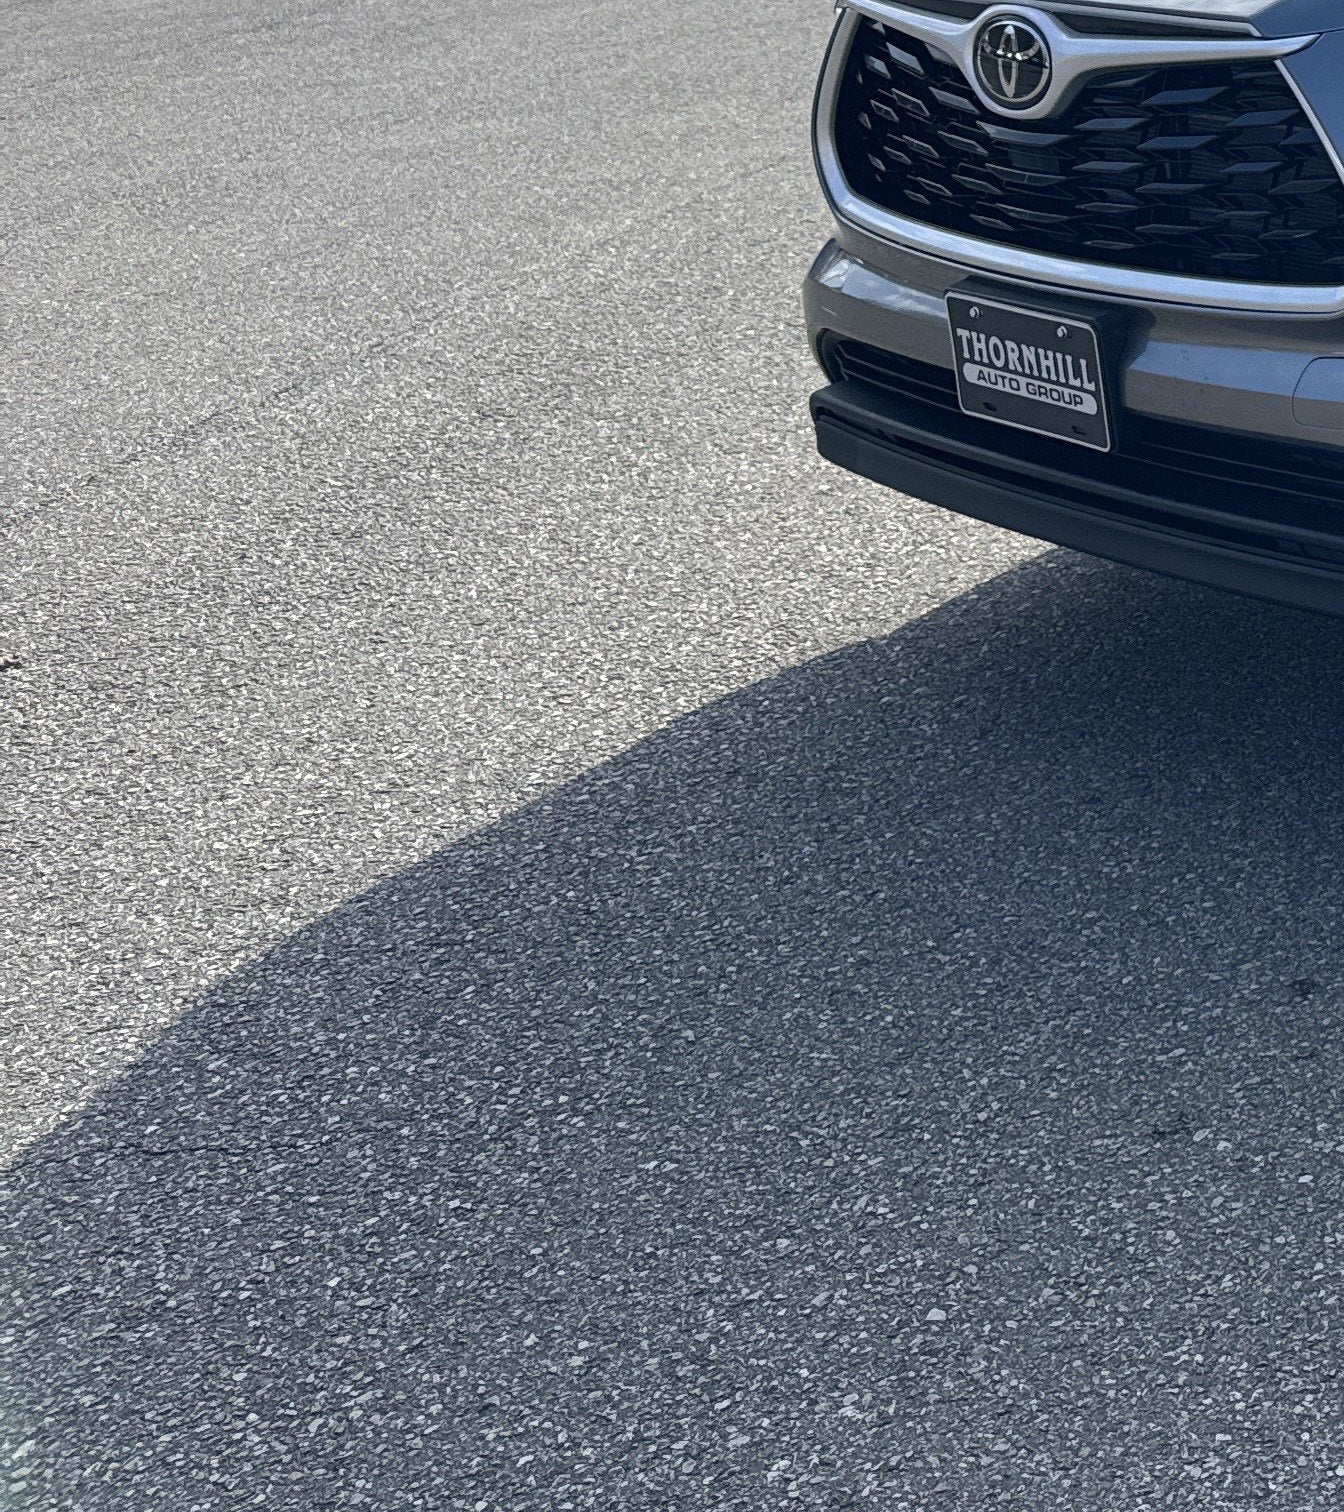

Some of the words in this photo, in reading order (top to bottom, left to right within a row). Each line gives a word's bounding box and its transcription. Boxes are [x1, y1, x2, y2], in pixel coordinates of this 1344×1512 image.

[956, 328, 1096, 391] THORNHILL
[976, 369, 1021, 392] AUTO
[1025, 382, 1084, 407] GROUP
